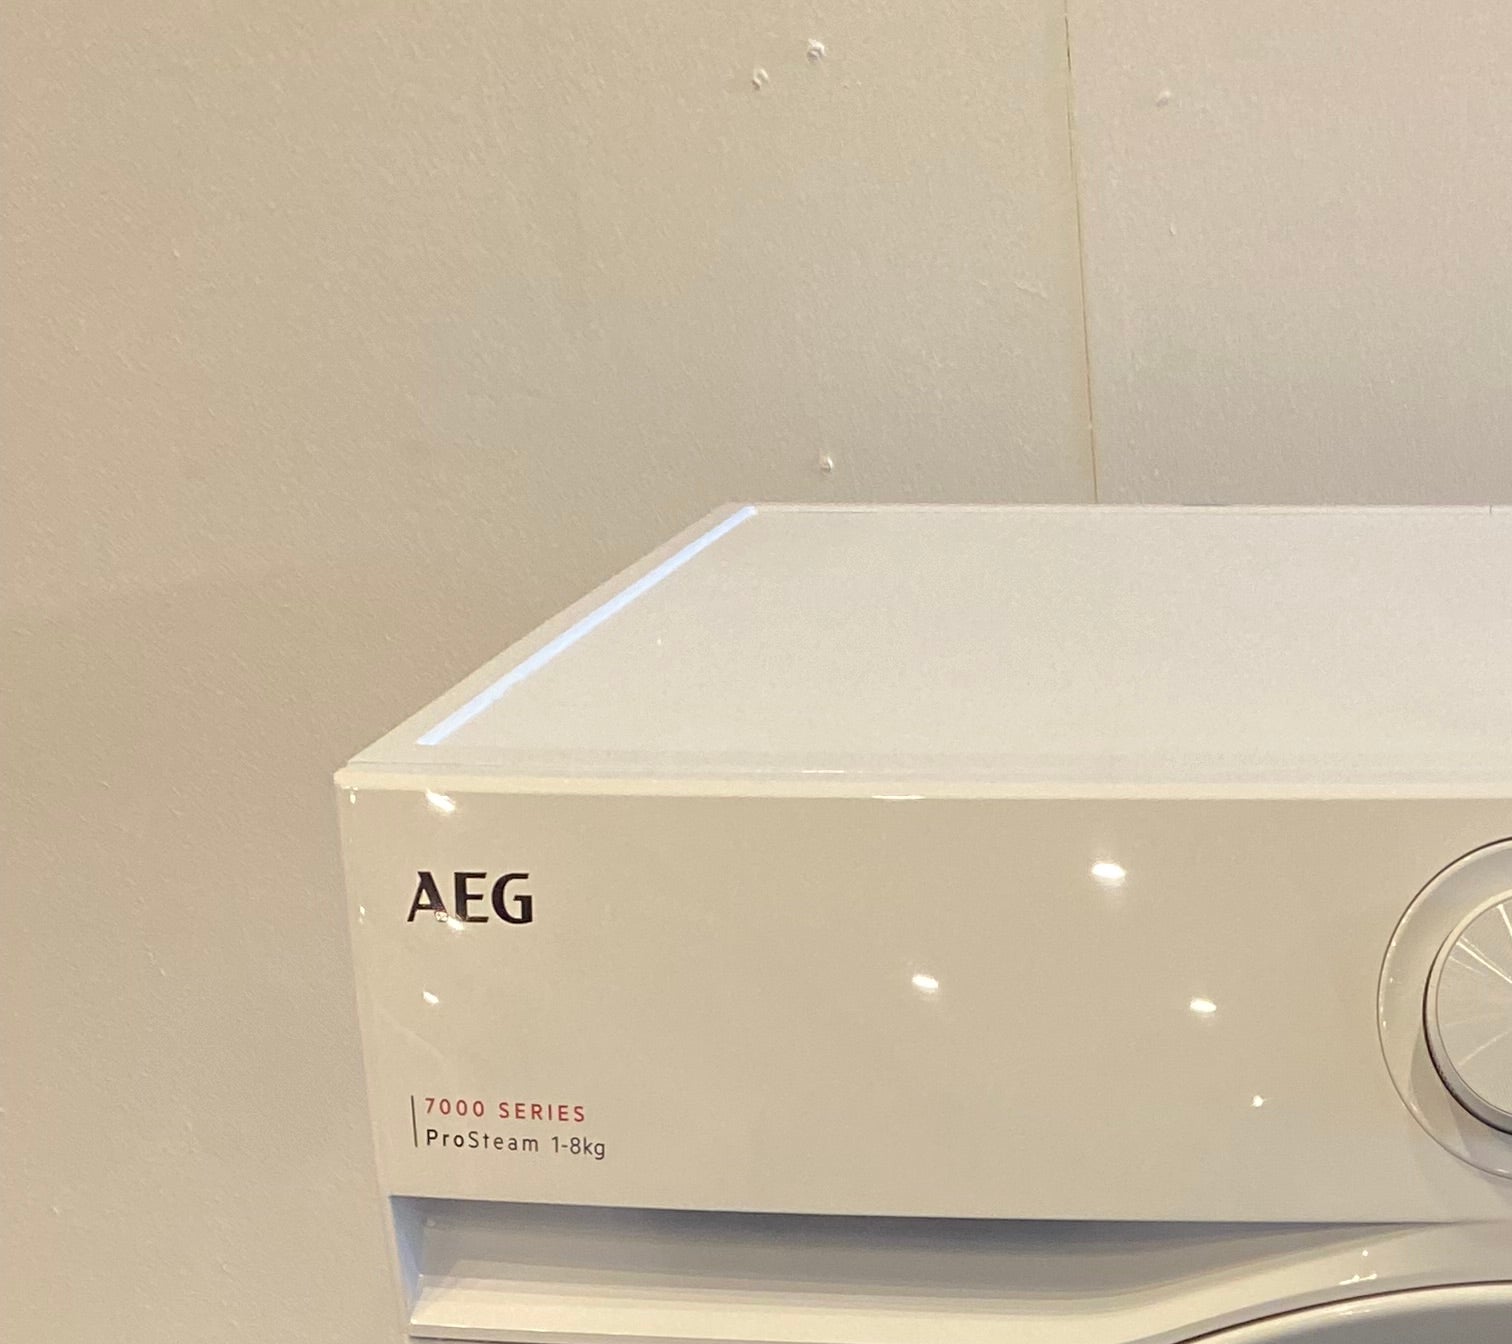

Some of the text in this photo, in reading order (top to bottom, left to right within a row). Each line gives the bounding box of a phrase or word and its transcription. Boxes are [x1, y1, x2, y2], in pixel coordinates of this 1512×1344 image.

[407, 871, 533, 924] AEG
[425, 1098, 586, 1123] 7000 SERIES
[426, 1128, 606, 1161] ProSteam 1-8kg
